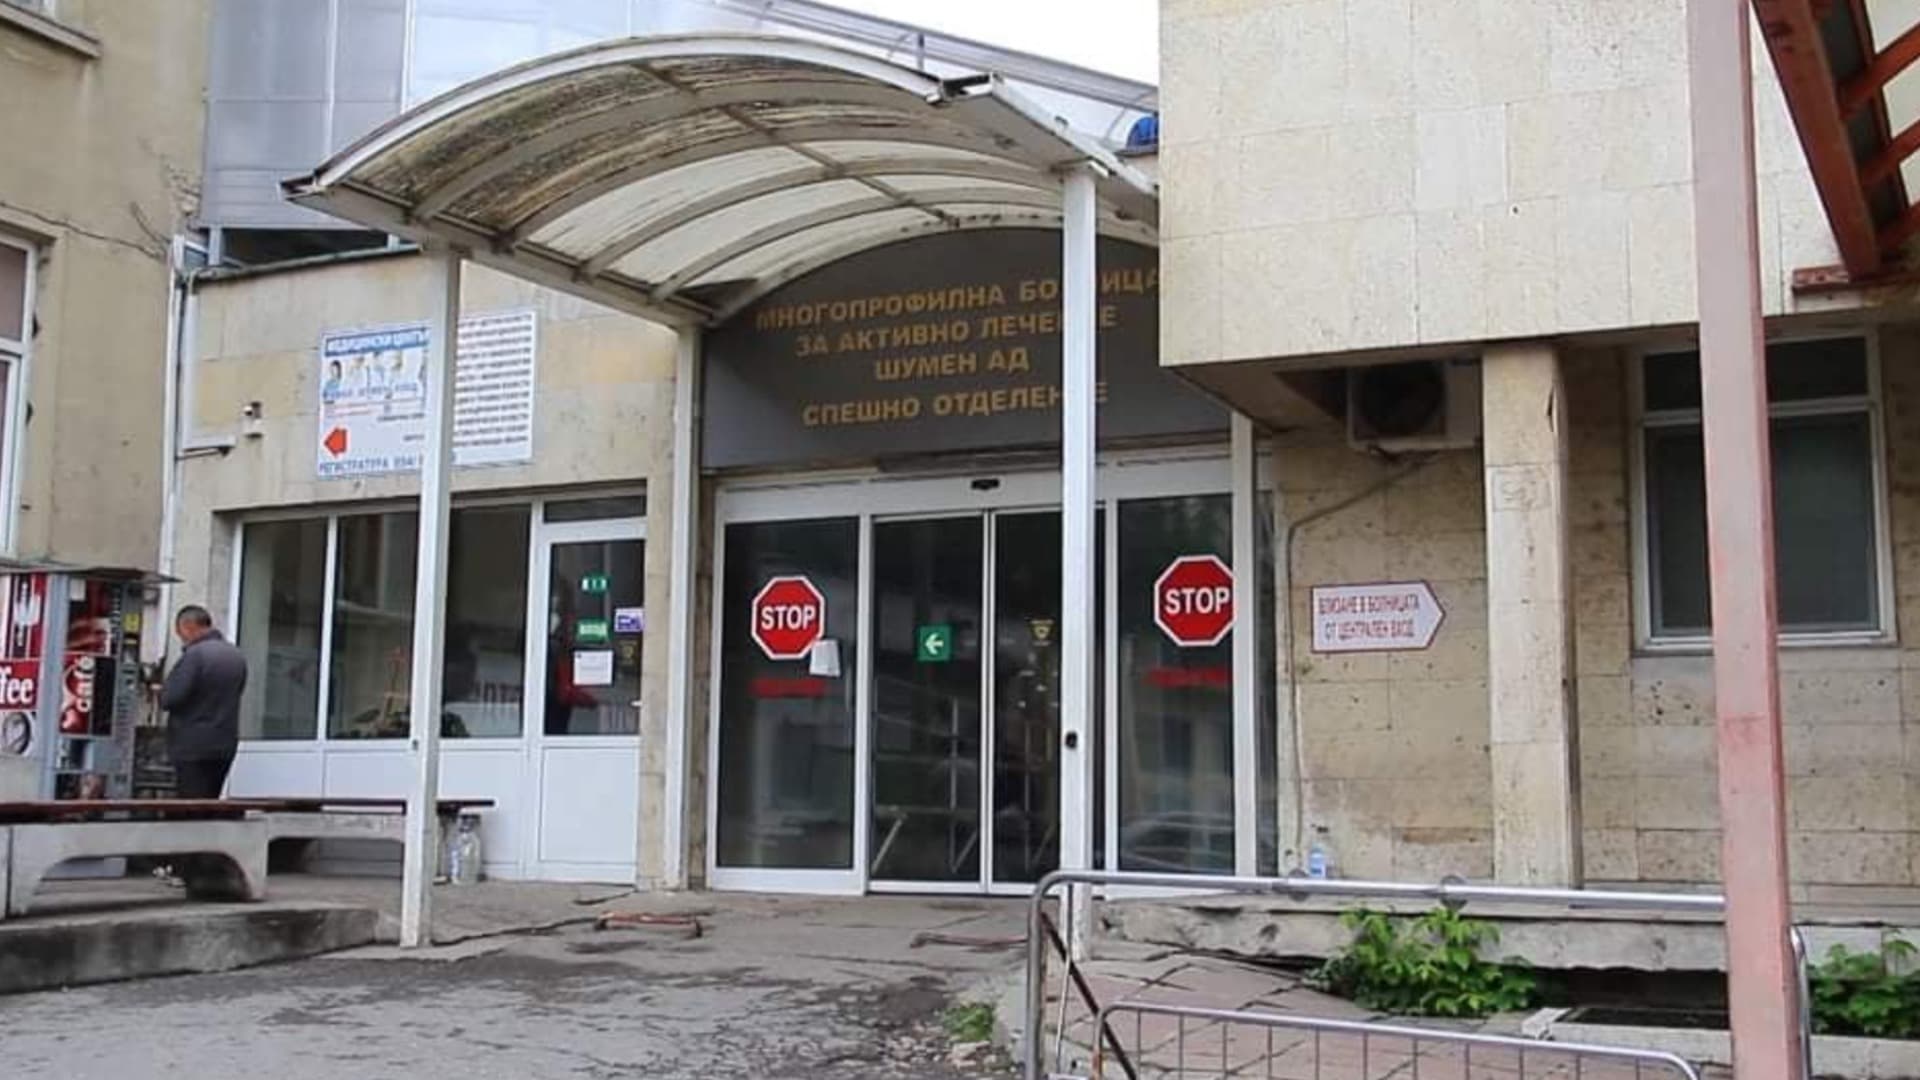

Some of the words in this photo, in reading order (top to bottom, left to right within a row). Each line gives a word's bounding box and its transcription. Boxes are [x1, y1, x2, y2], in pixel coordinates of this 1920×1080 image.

[756, 284, 1006, 330] МНОГОПРОФИЛНА
[1019, 268, 1160, 303] БОИЦА
[796, 333, 830, 357] ЗА
[838, 320, 971, 352] АКТИВНО
[981, 304, 1118, 340] ЛЕЧЕЕ
[875, 352, 977, 382] ШУМЕН
[988, 346, 1030, 373] АД
[802, 395, 921, 427] СПЕШНО
[932, 382, 1109, 417] ОТДЕЛЕНЕ
[760, 605, 818, 630] STOP
[1164, 586, 1231, 615] STOP
